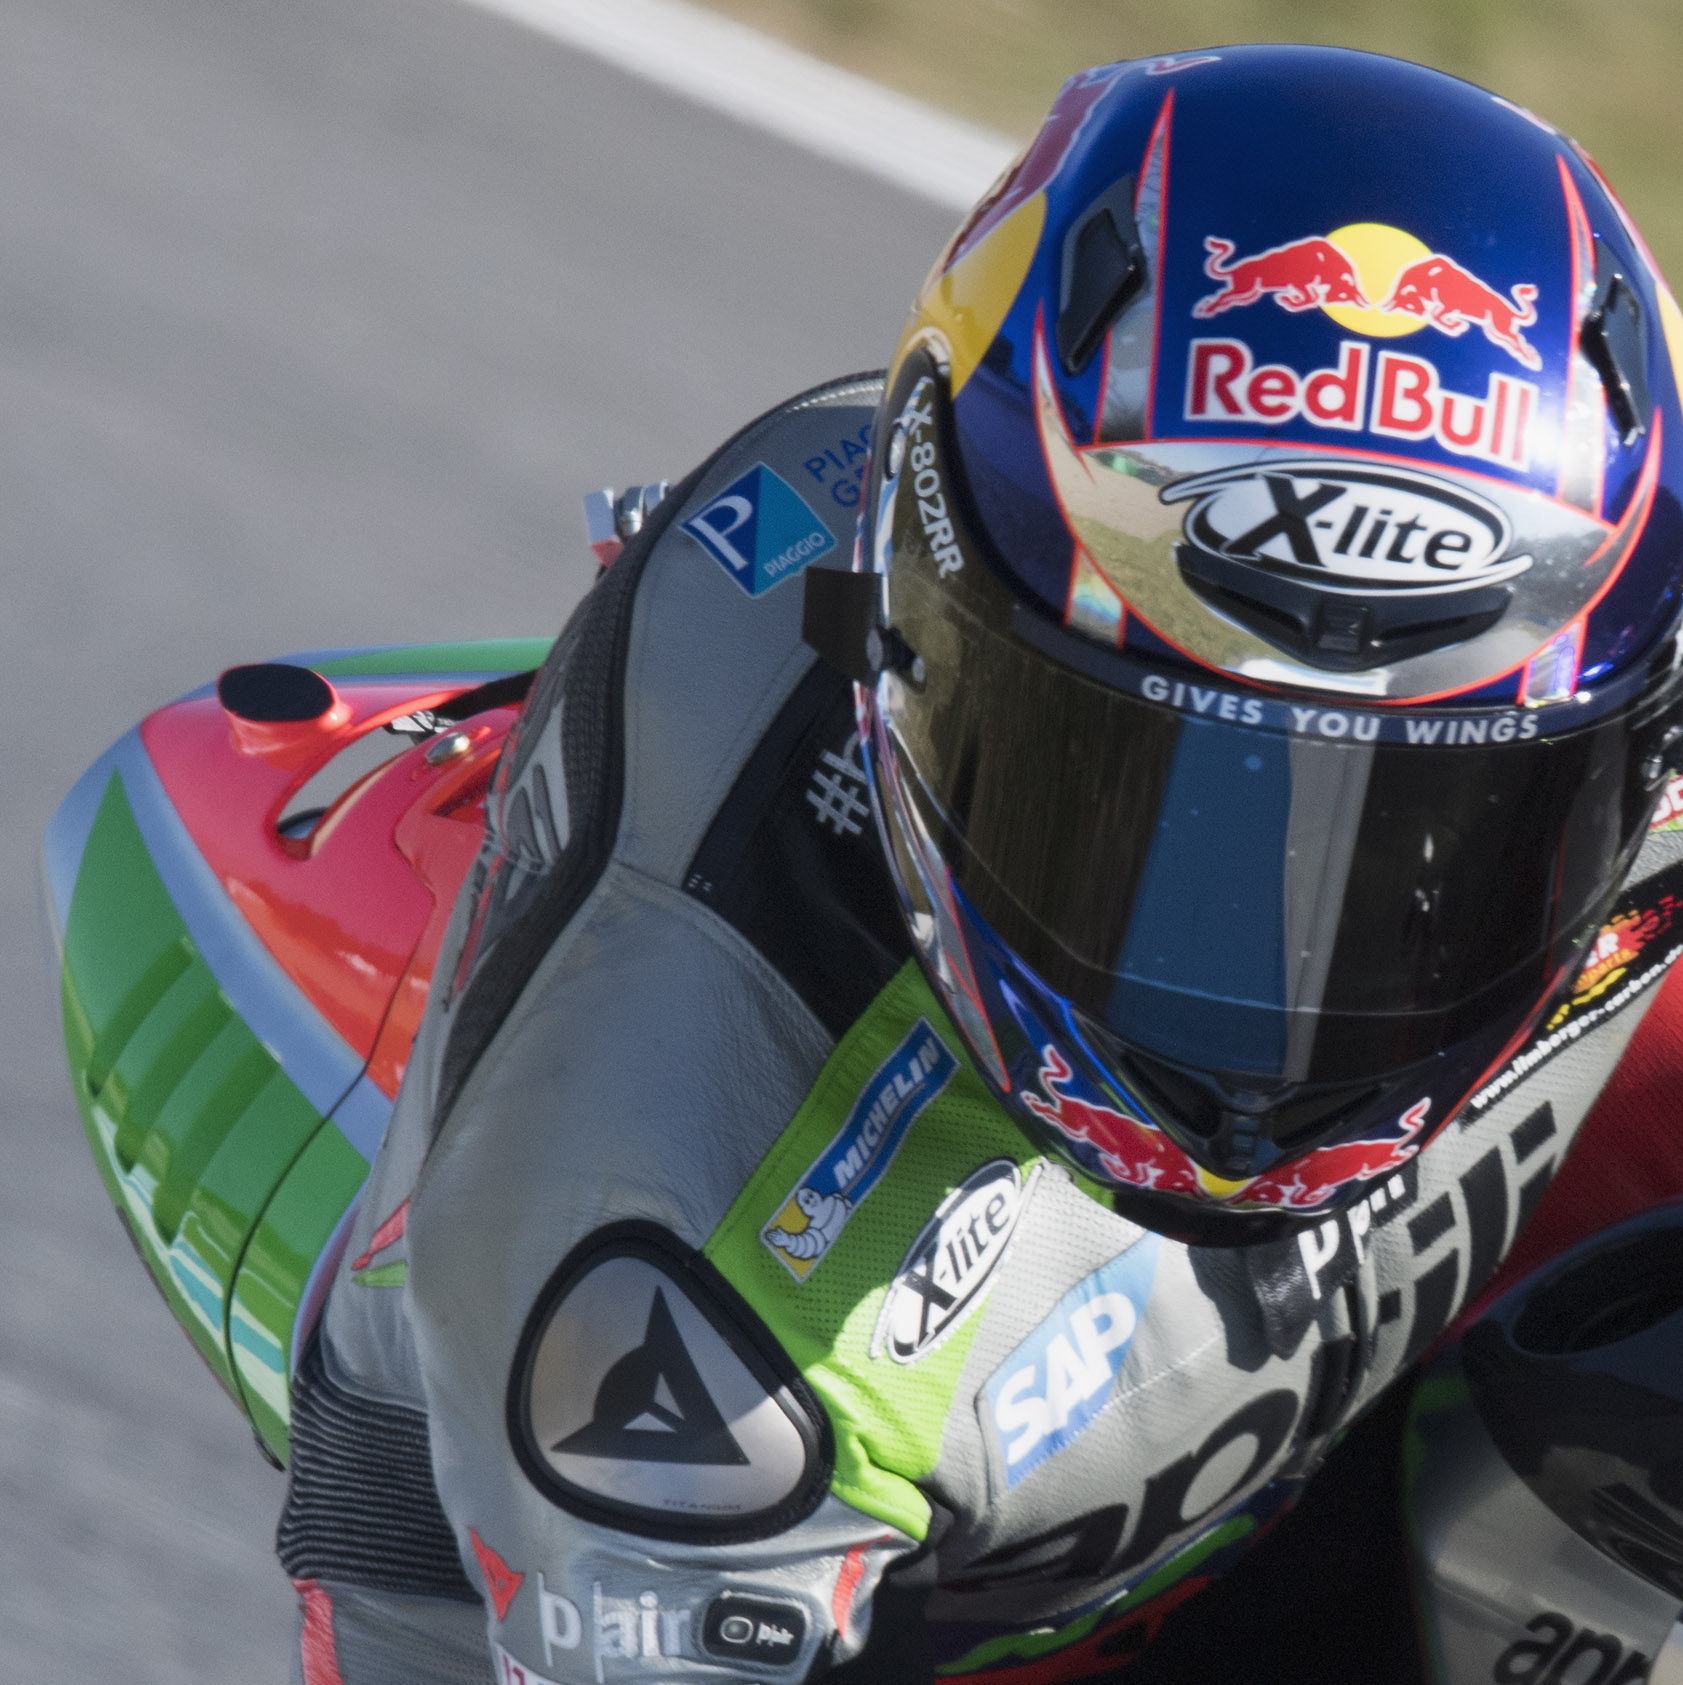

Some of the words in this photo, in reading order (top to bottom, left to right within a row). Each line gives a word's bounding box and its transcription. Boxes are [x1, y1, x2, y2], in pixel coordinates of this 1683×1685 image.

[1186, 341, 1365, 424] Red
[1379, 358, 1534, 467] Bull
[764, 531, 826, 577] PIAGGIO
[1222, 472, 1475, 569] X-lite
[1142, 674, 1263, 725] GIVES
[1291, 706, 1379, 741] YOU
[1406, 714, 1540, 744] WINGS
[834, 1039, 940, 1189] MICHELIN
[900, 1182, 1011, 1347] X-lite
[1001, 1291, 1136, 1465] SAP
